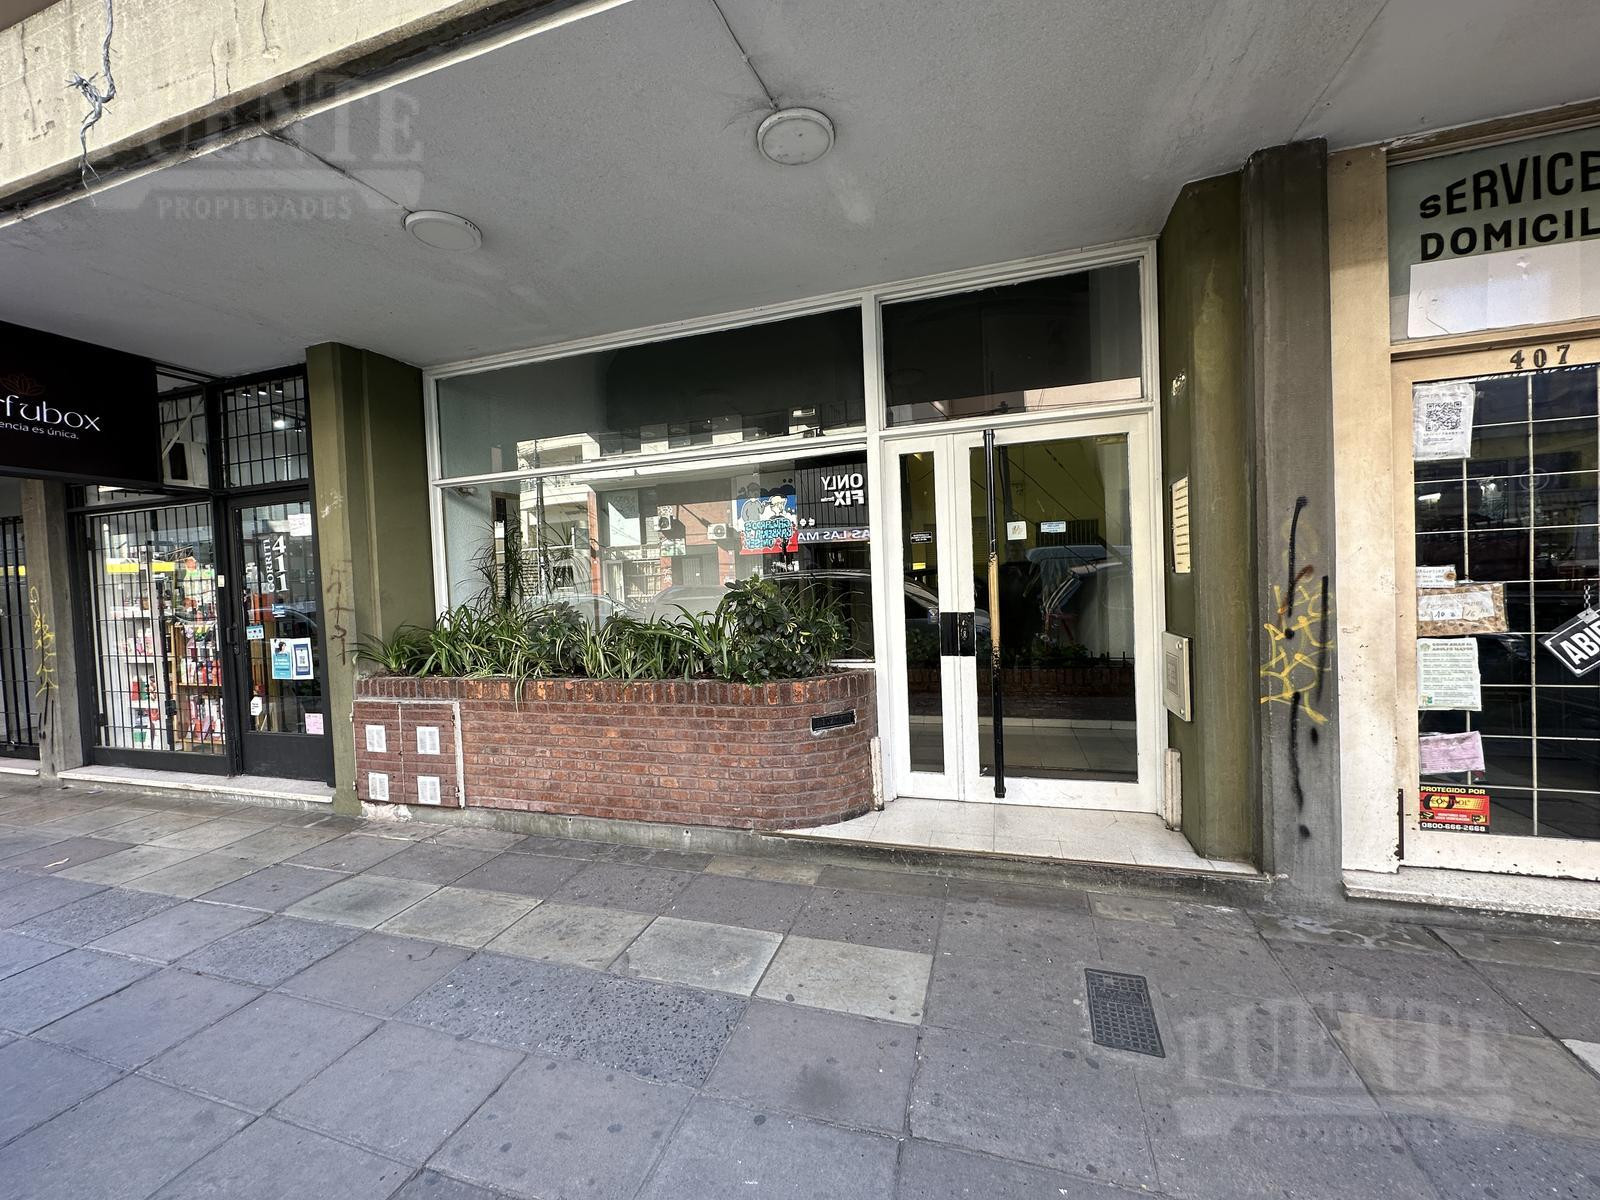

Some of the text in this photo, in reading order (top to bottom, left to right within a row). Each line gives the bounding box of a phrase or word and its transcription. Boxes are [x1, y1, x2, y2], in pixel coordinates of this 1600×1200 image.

[1419, 151, 1600, 219] SERVICE
[1420, 207, 1600, 261] DOMICIL
[1509, 343, 1571, 370] 407
[31, 426, 45, 434] es
[47, 427, 80, 440] única.
[272, 535, 290, 593] 411
[1420, 786, 1466, 794] PROTEGIDO
